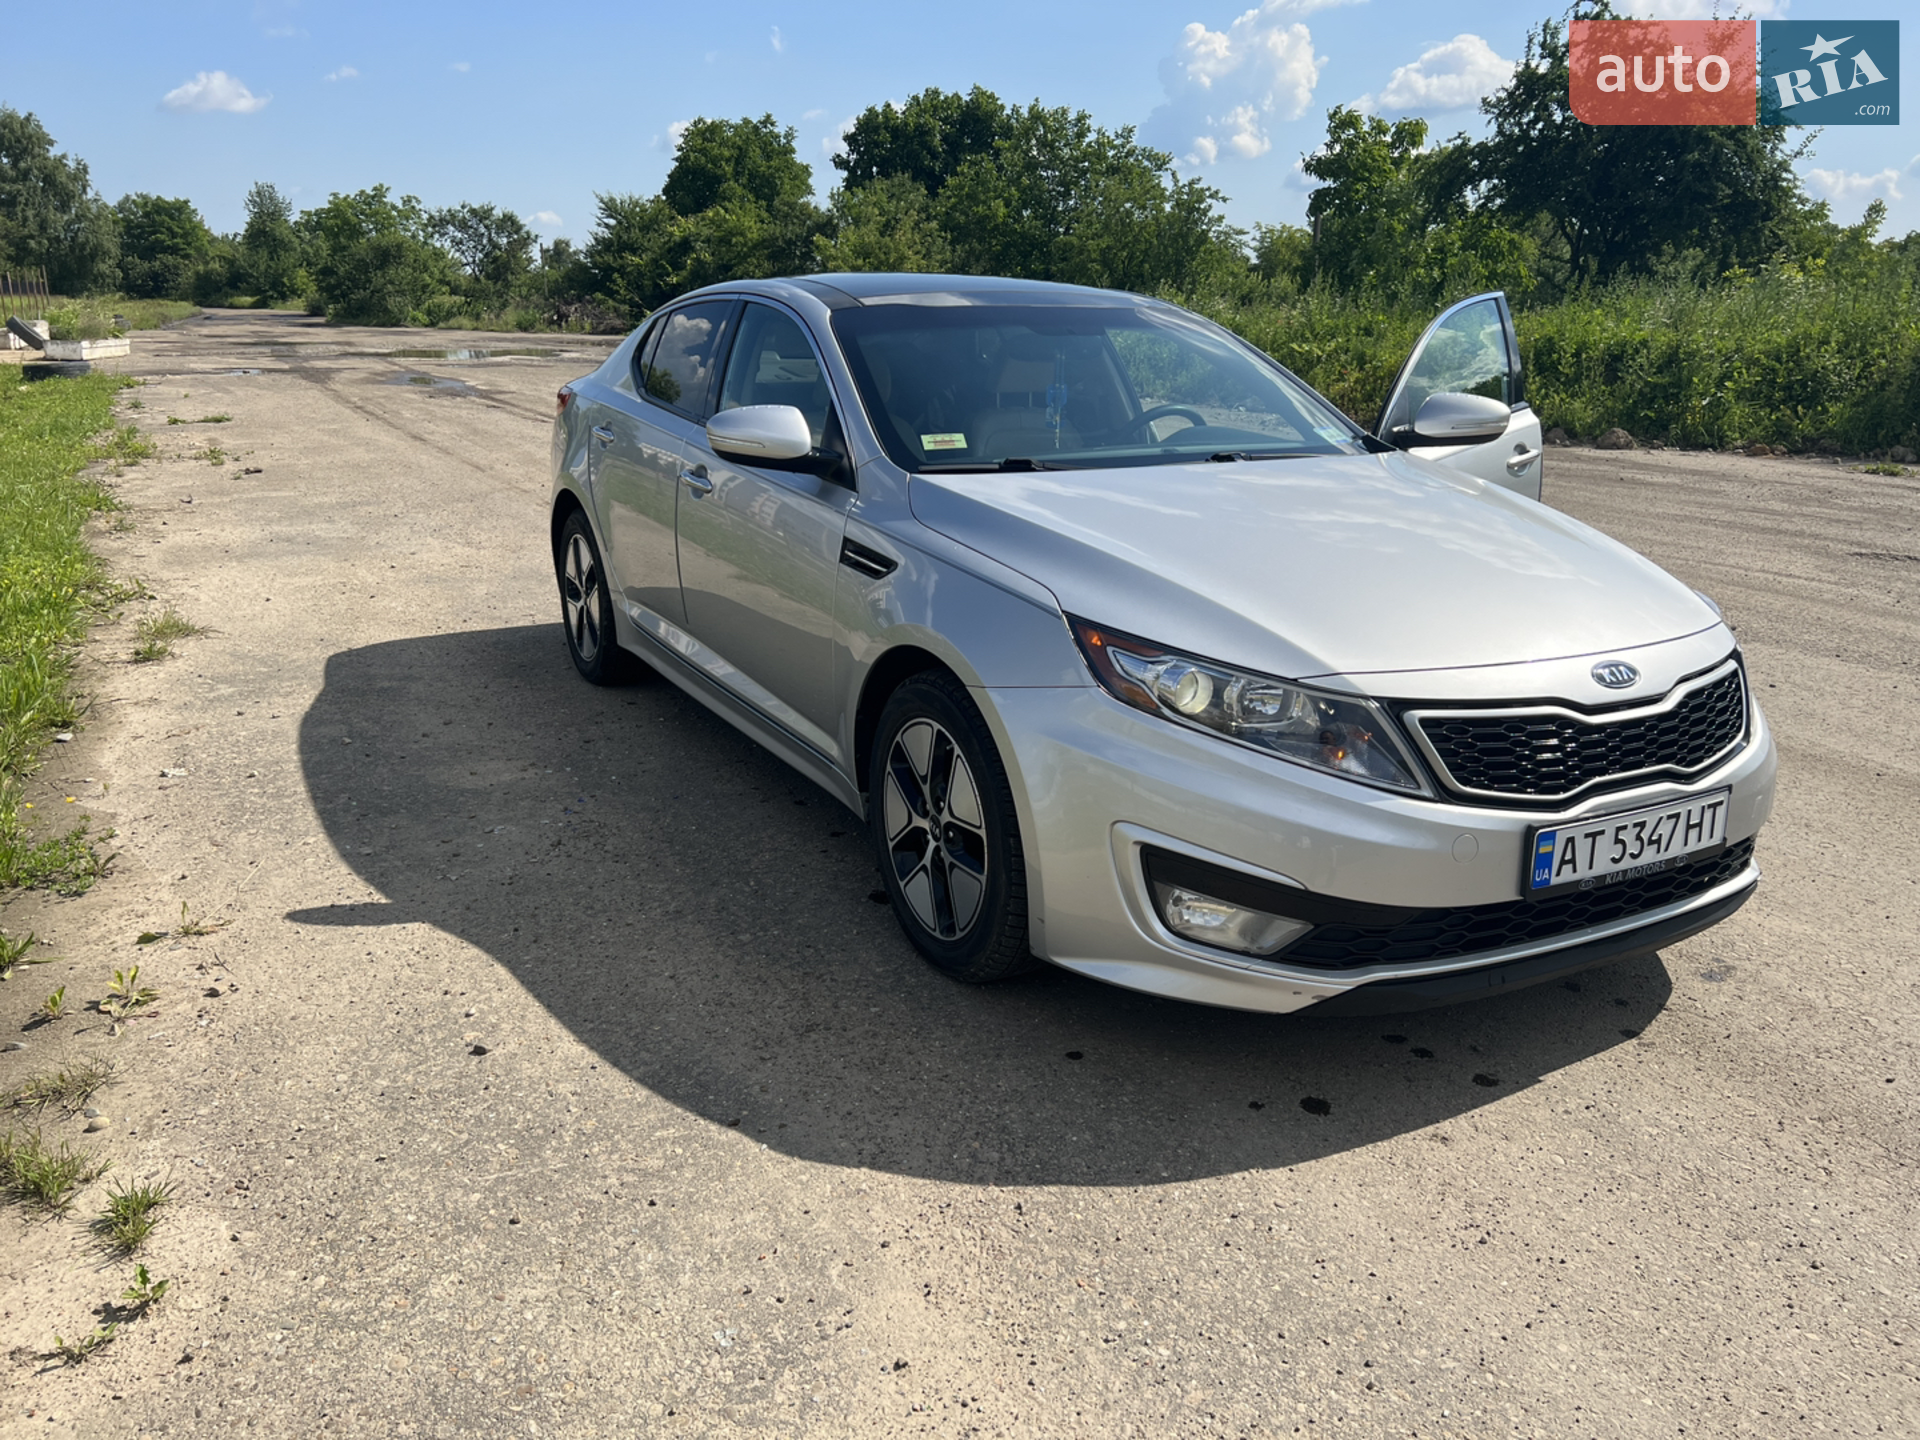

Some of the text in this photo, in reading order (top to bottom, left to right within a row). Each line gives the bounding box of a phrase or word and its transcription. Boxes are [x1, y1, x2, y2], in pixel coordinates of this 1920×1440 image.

[1555, 828, 1606, 878] AT
[1535, 868, 1550, 882] UA
[1604, 872, 1623, 885] KIA
[1625, 860, 1666, 880] MOTORS
